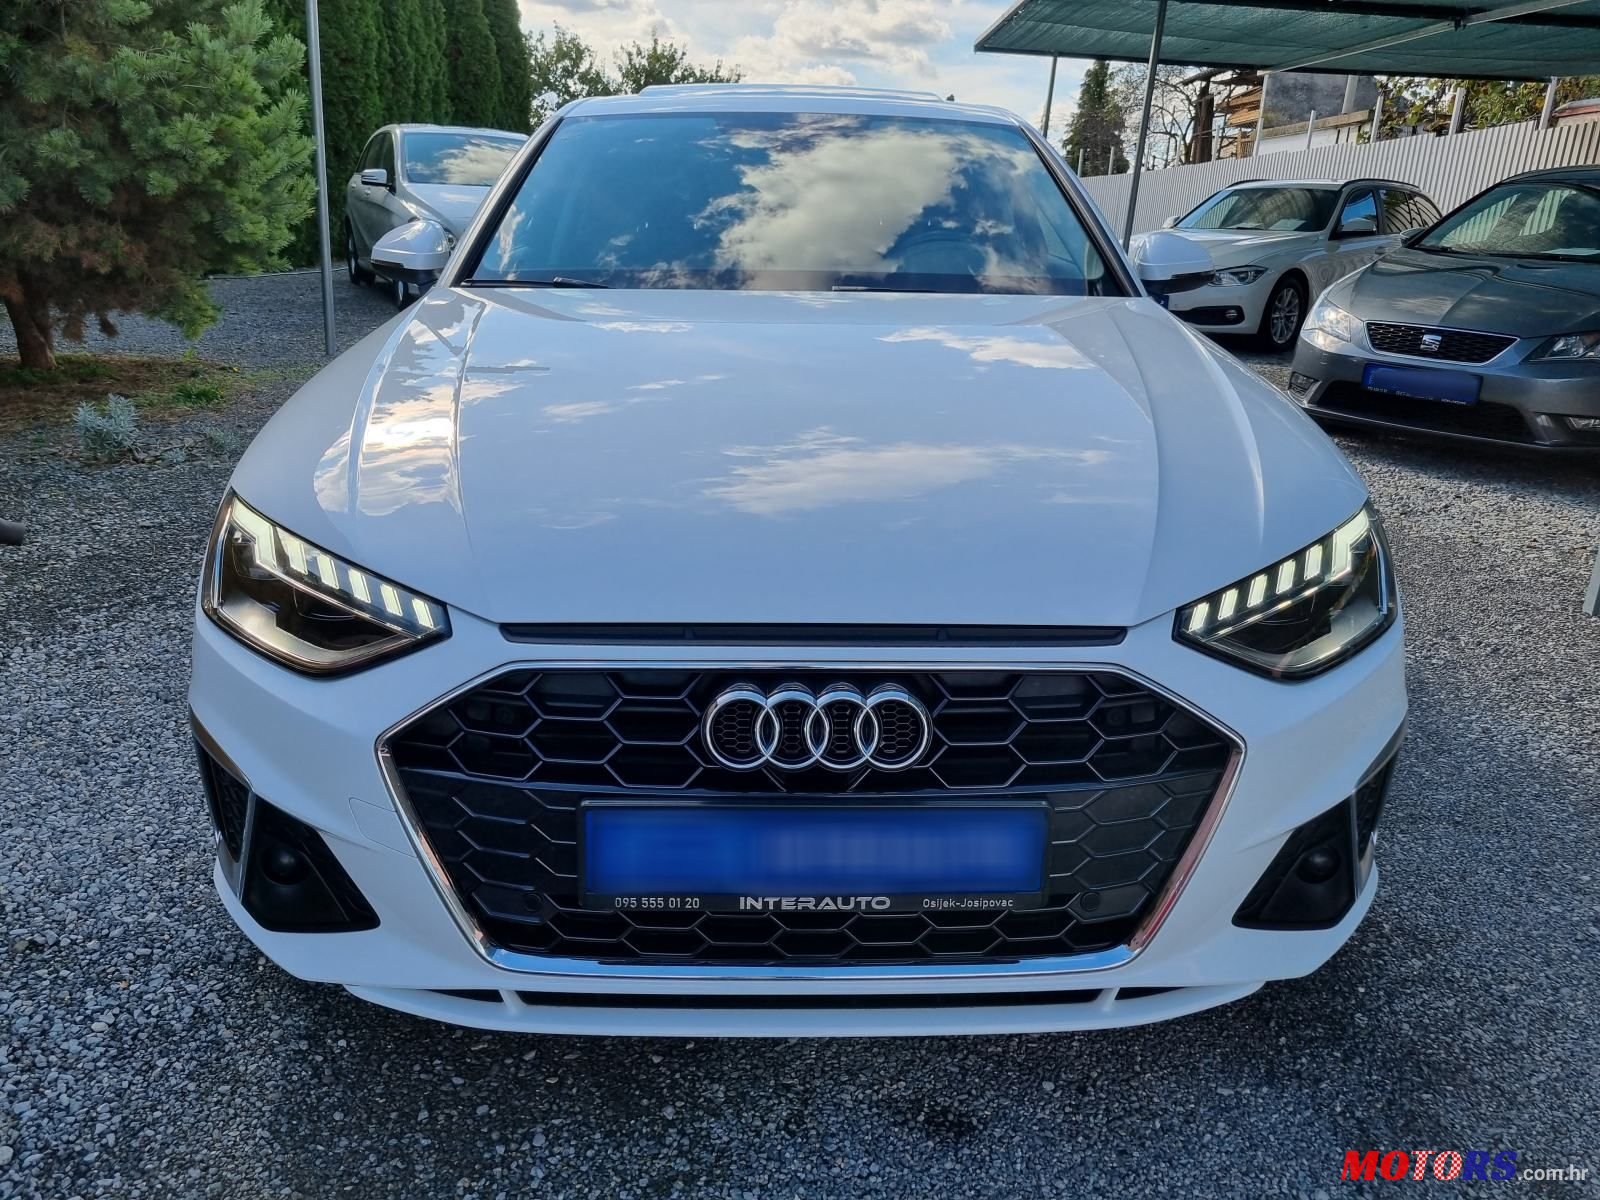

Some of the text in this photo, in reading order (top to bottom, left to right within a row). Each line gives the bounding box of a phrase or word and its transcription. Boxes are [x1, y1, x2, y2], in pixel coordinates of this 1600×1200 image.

[615, 897, 700, 909] 095 555 01 20
[739, 896, 891, 910] INTERAUTO
[922, 898, 1014, 910] Osijek-Josipovac
